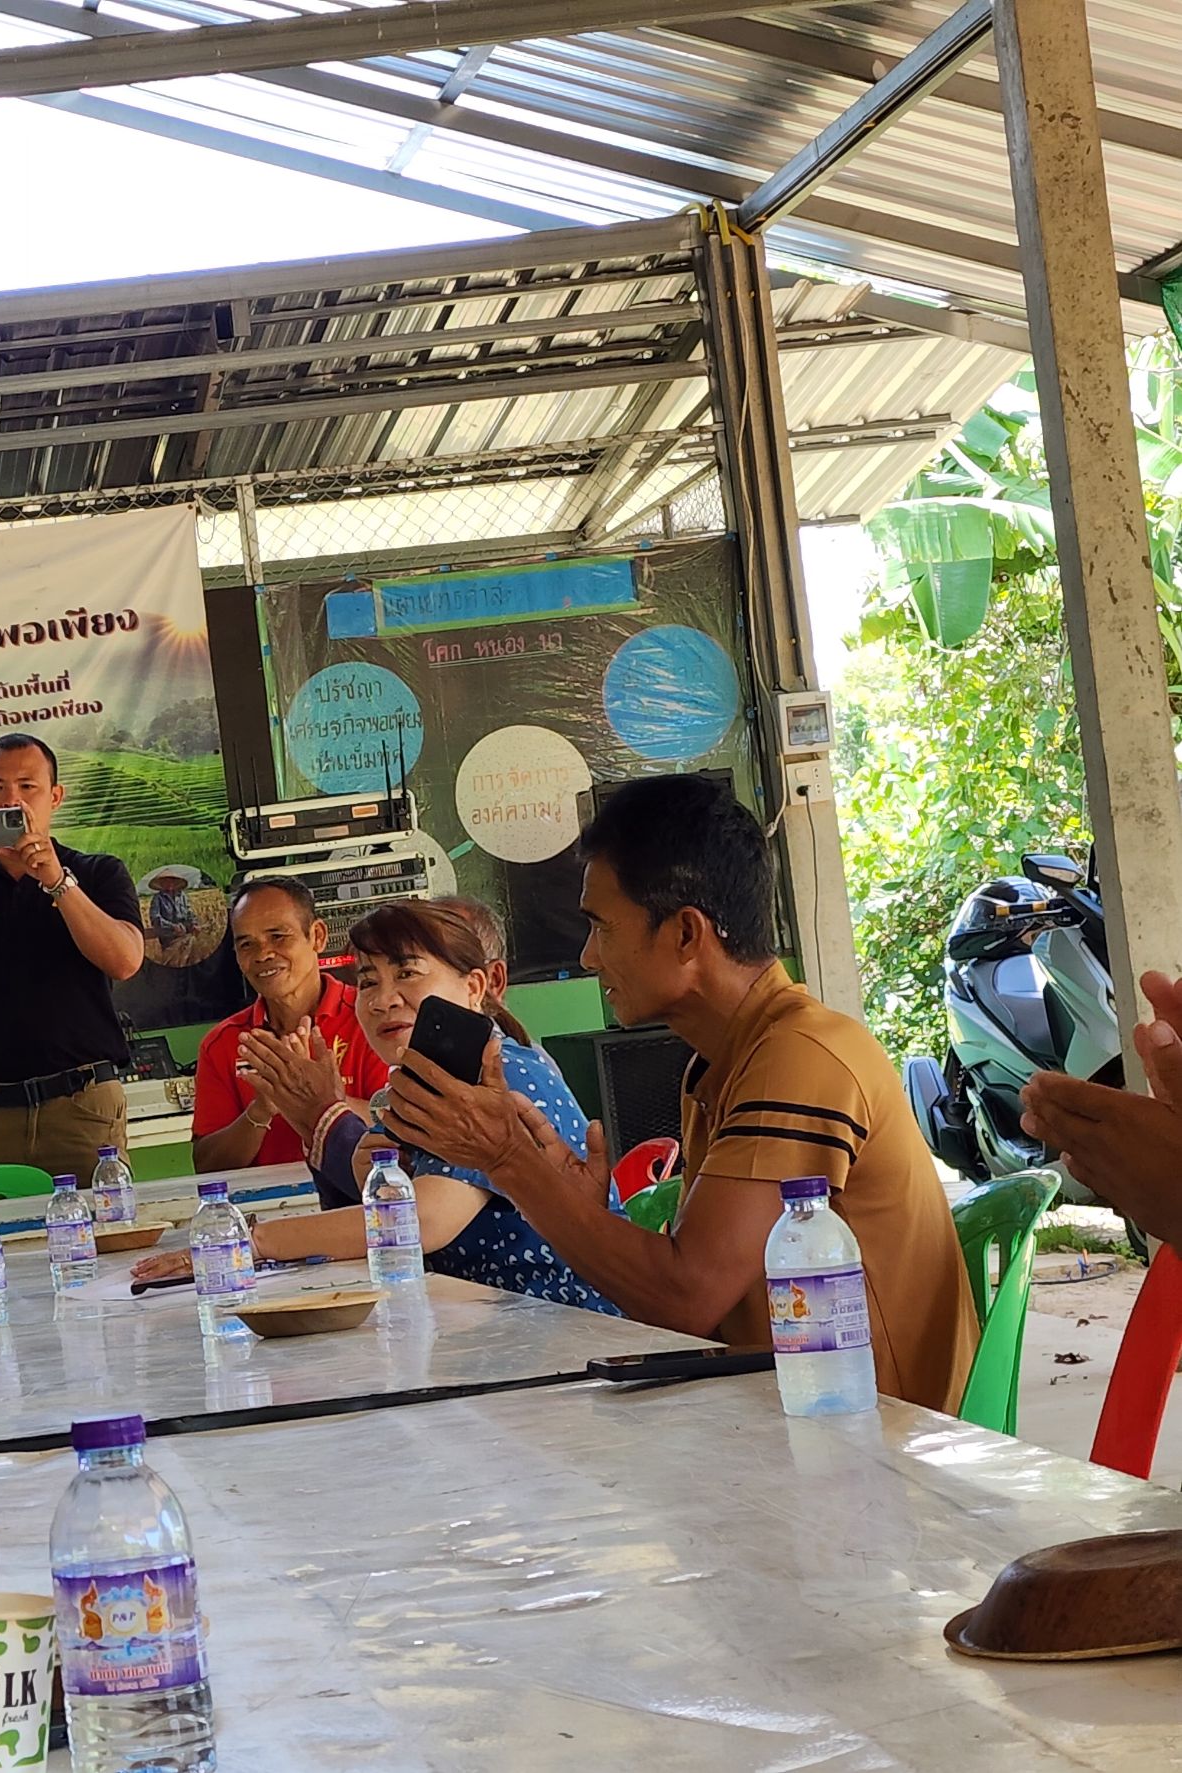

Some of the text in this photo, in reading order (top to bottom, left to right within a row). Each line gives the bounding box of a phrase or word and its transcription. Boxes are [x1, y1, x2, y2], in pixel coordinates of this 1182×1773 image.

[423, 638, 462, 662] โคก
[315, 674, 382, 703] ปรัชญา
[1, 1710, 30, 1727] fresh
